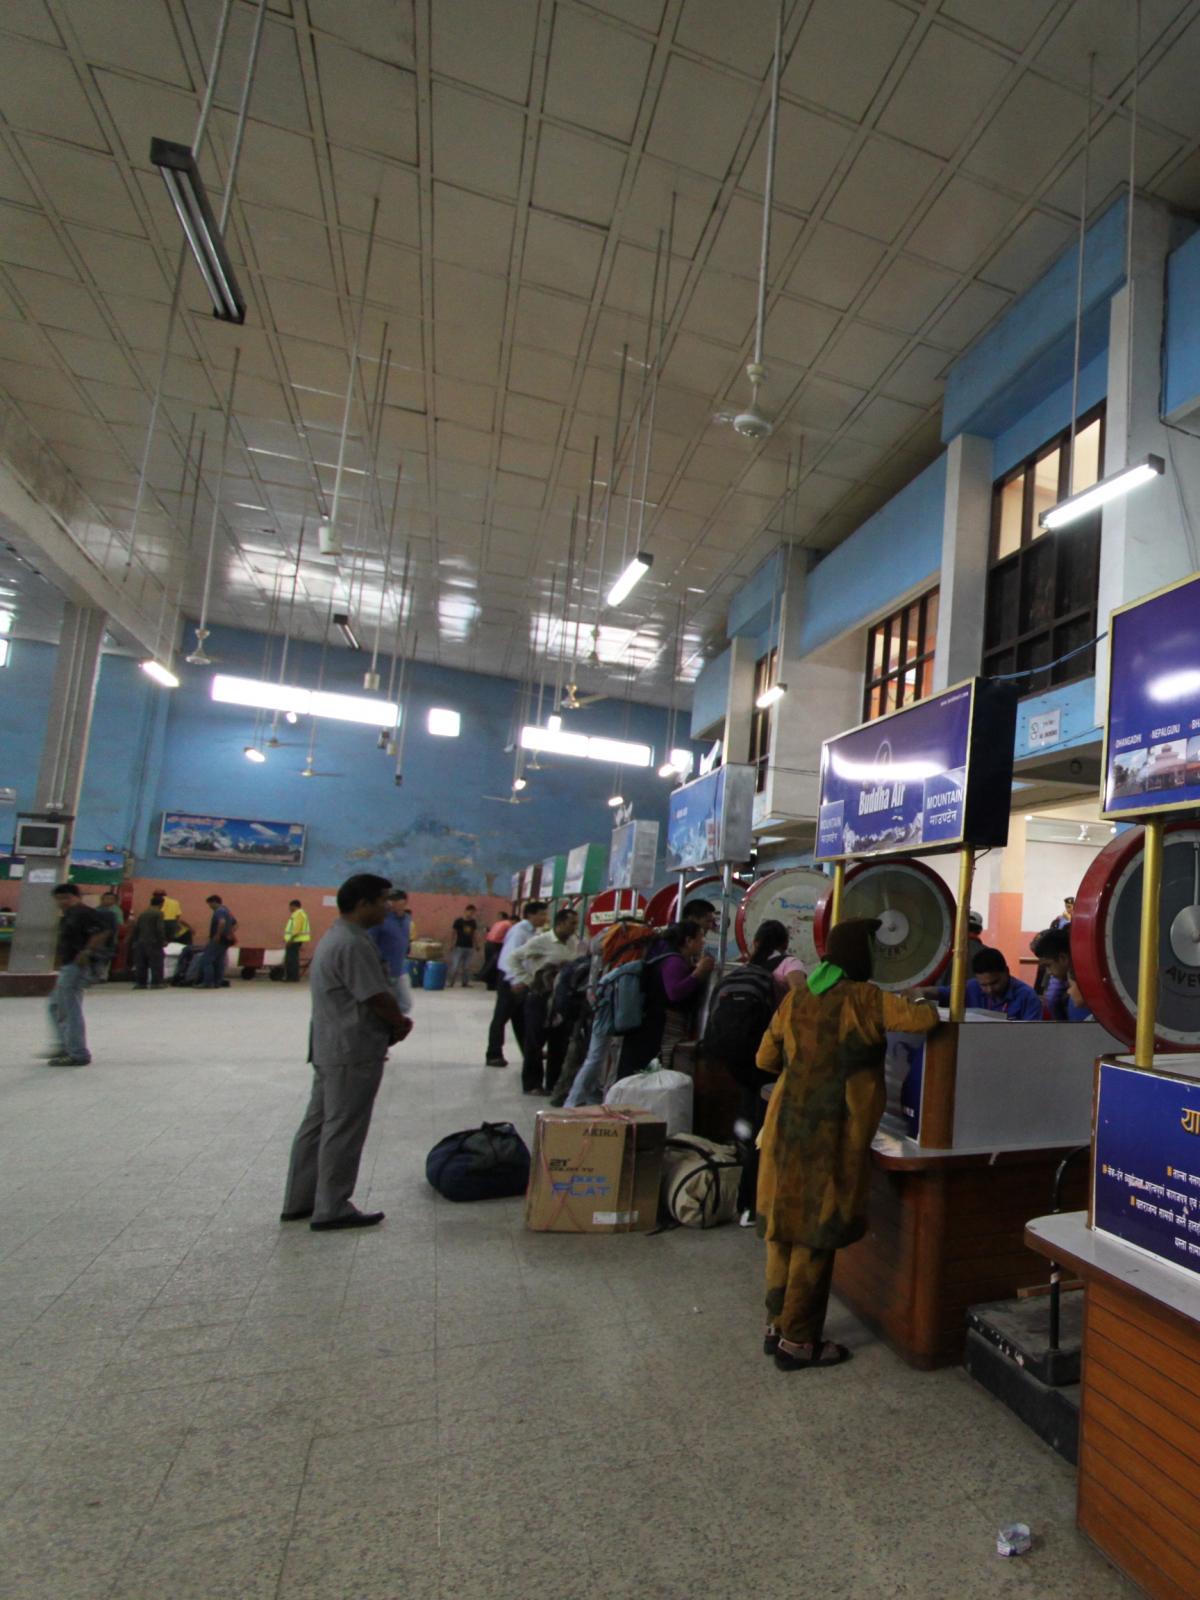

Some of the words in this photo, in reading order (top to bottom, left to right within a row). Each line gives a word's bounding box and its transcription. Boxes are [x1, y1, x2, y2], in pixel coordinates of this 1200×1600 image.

[858, 785, 890, 816] Buddha
[891, 782, 906, 809] Air
[926, 789, 963, 810] MOUNTAIN
